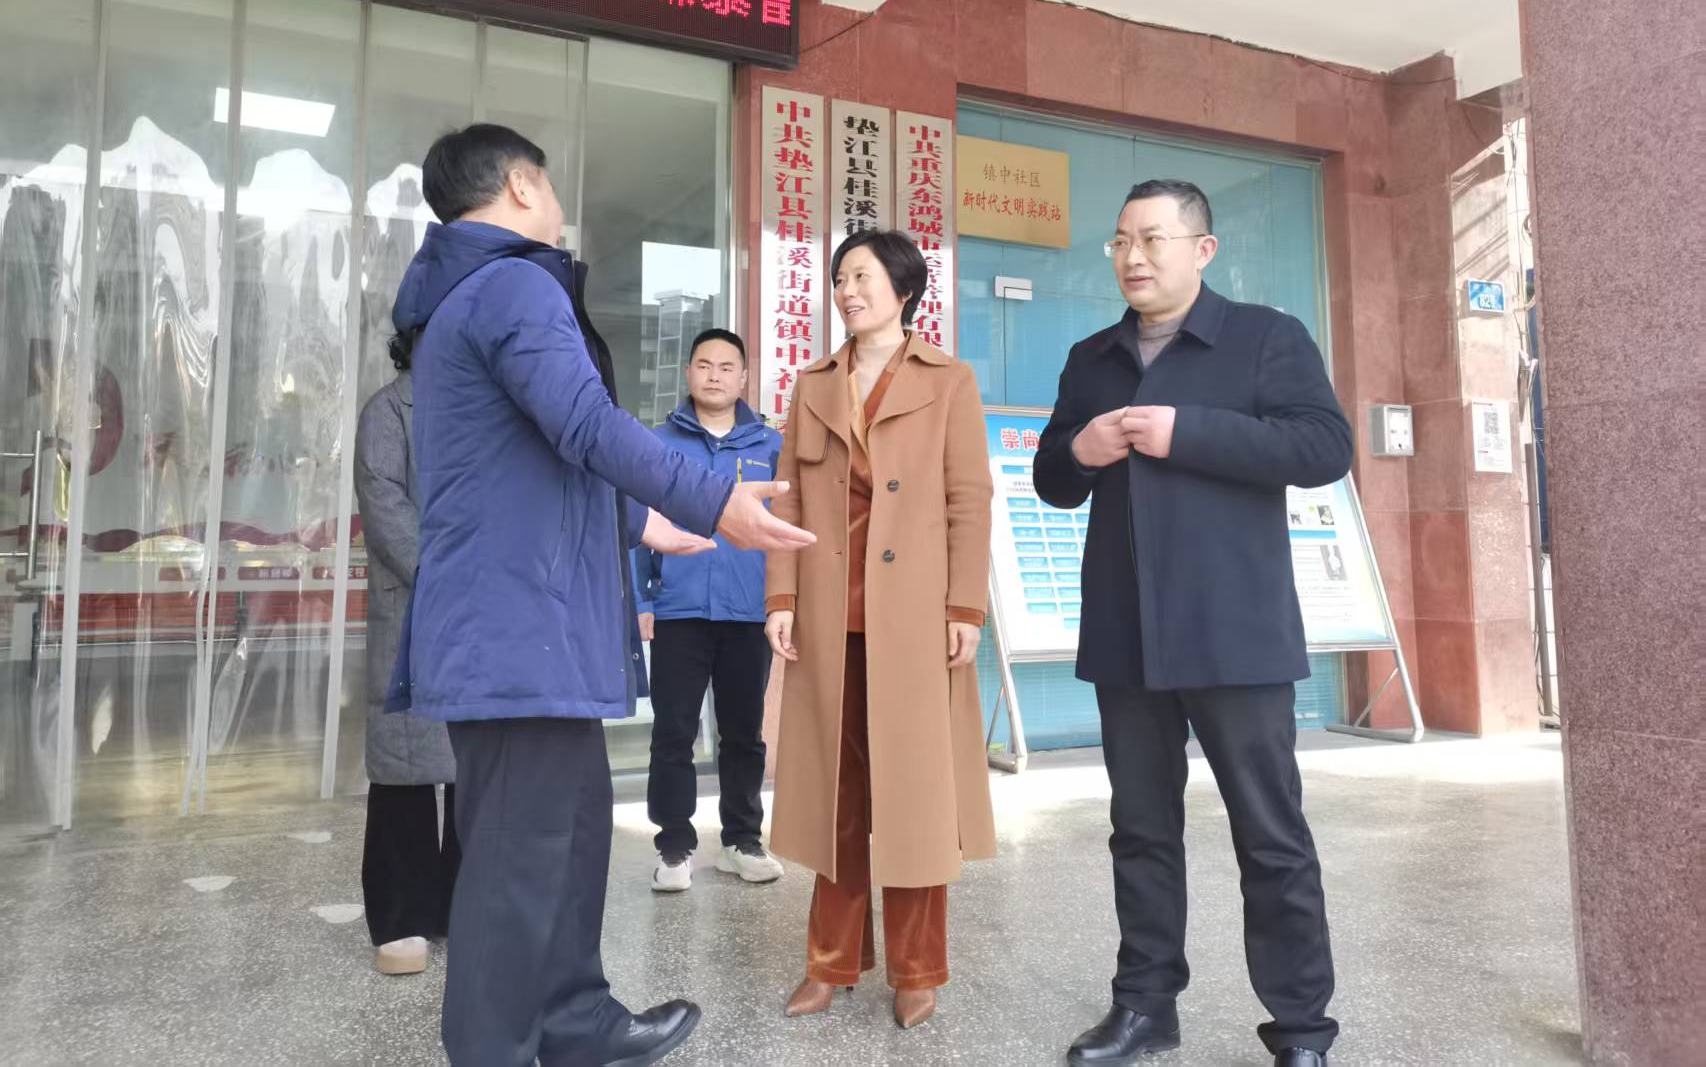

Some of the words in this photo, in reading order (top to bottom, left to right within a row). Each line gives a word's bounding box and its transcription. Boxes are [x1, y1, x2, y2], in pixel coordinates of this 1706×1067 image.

[983, 163, 1041, 188] 镇中社区
[962, 189, 1062, 221] 新时代文明实践站
[1001, 428, 1041, 450] 崇尚
